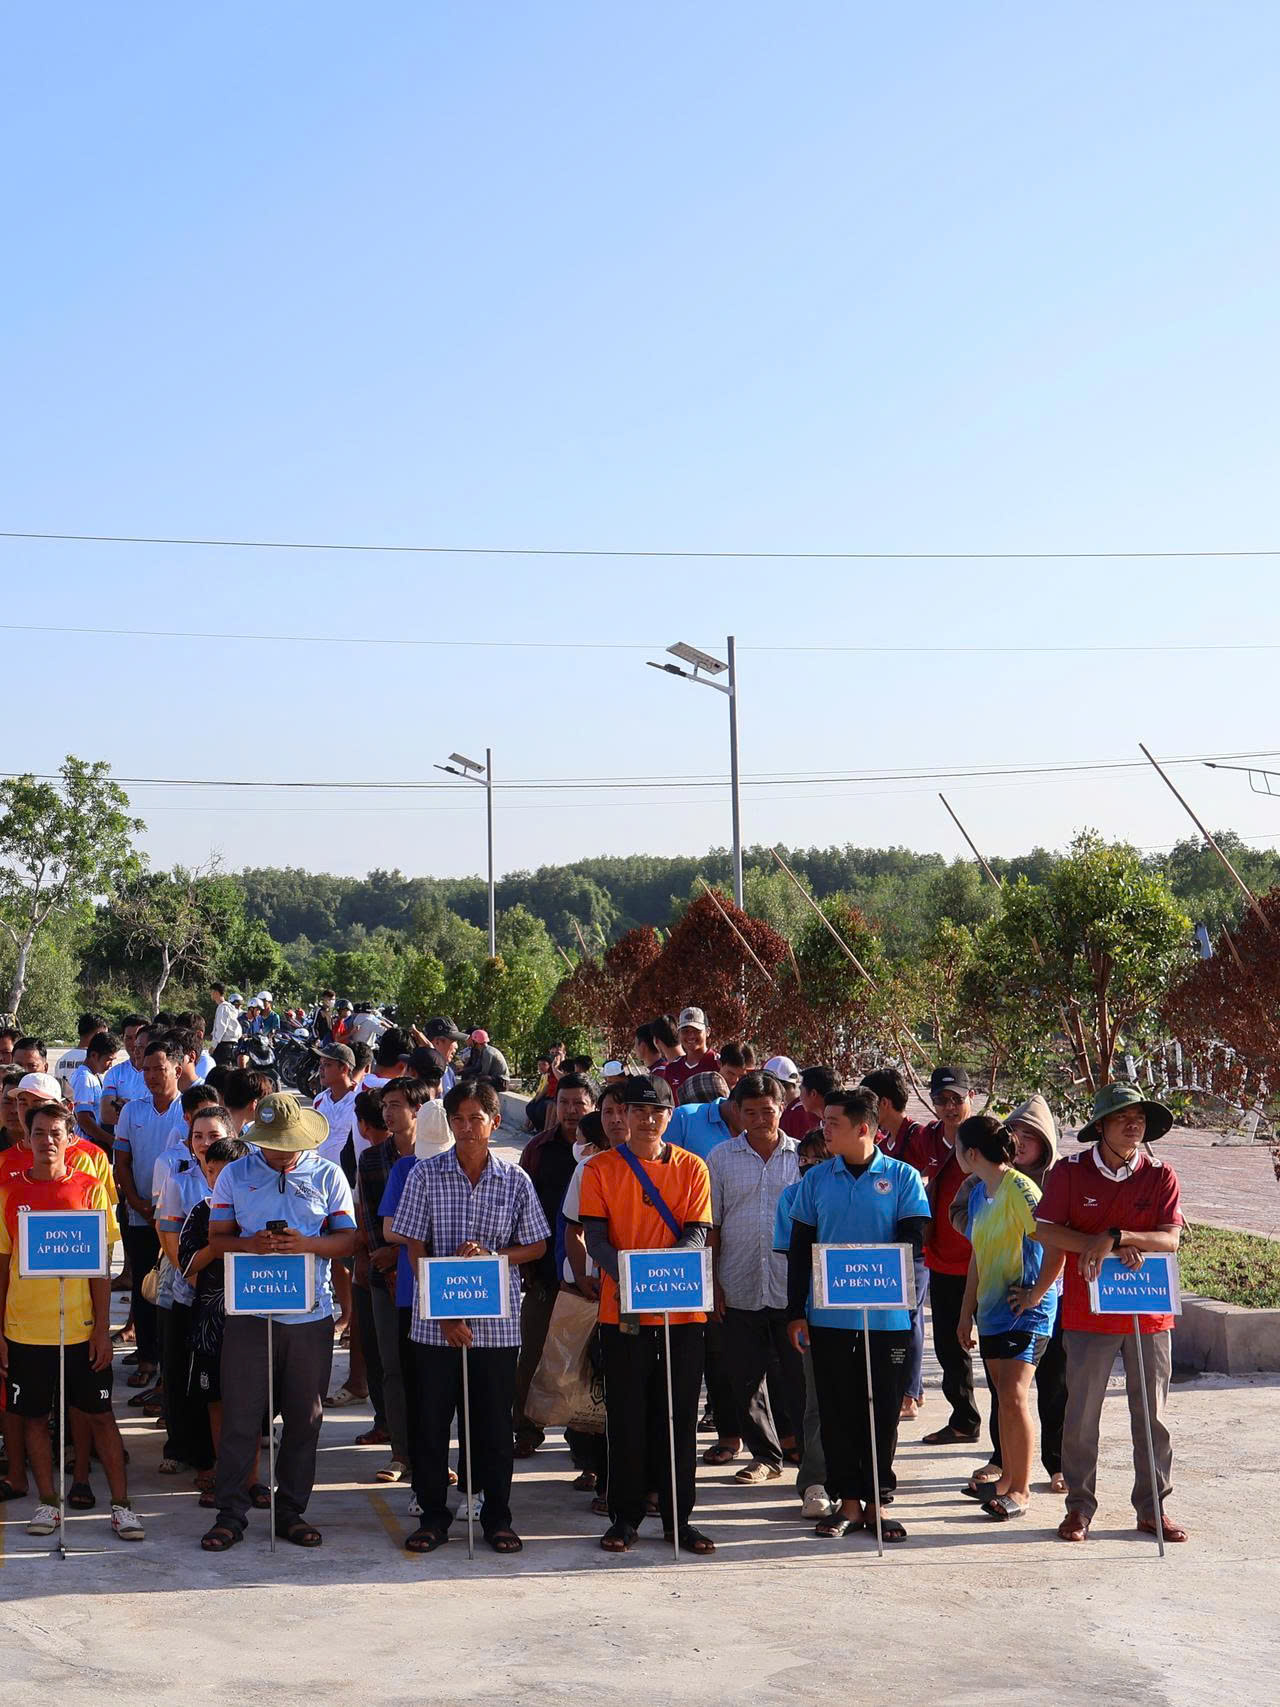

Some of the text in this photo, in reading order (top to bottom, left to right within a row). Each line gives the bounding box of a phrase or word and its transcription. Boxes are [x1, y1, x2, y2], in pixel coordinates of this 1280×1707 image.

[45, 1230, 82, 1241] ĐƠN VỊ
[648, 1268, 684, 1279] ĐƠN VỊ
[845, 1264, 883, 1274] ĐƠN VỊ
[252, 1270, 288, 1280] ĐƠN VỊ
[1114, 1272, 1150, 1283] ĐƠN VỊ
[446, 1276, 482, 1286] ĐƠN VỊ
[649, 1281, 668, 1292] CÁI
[671, 1282, 700, 1291] NGAY
[874, 1277, 897, 1289] DỰA
[1117, 1287, 1137, 1296] MAI
